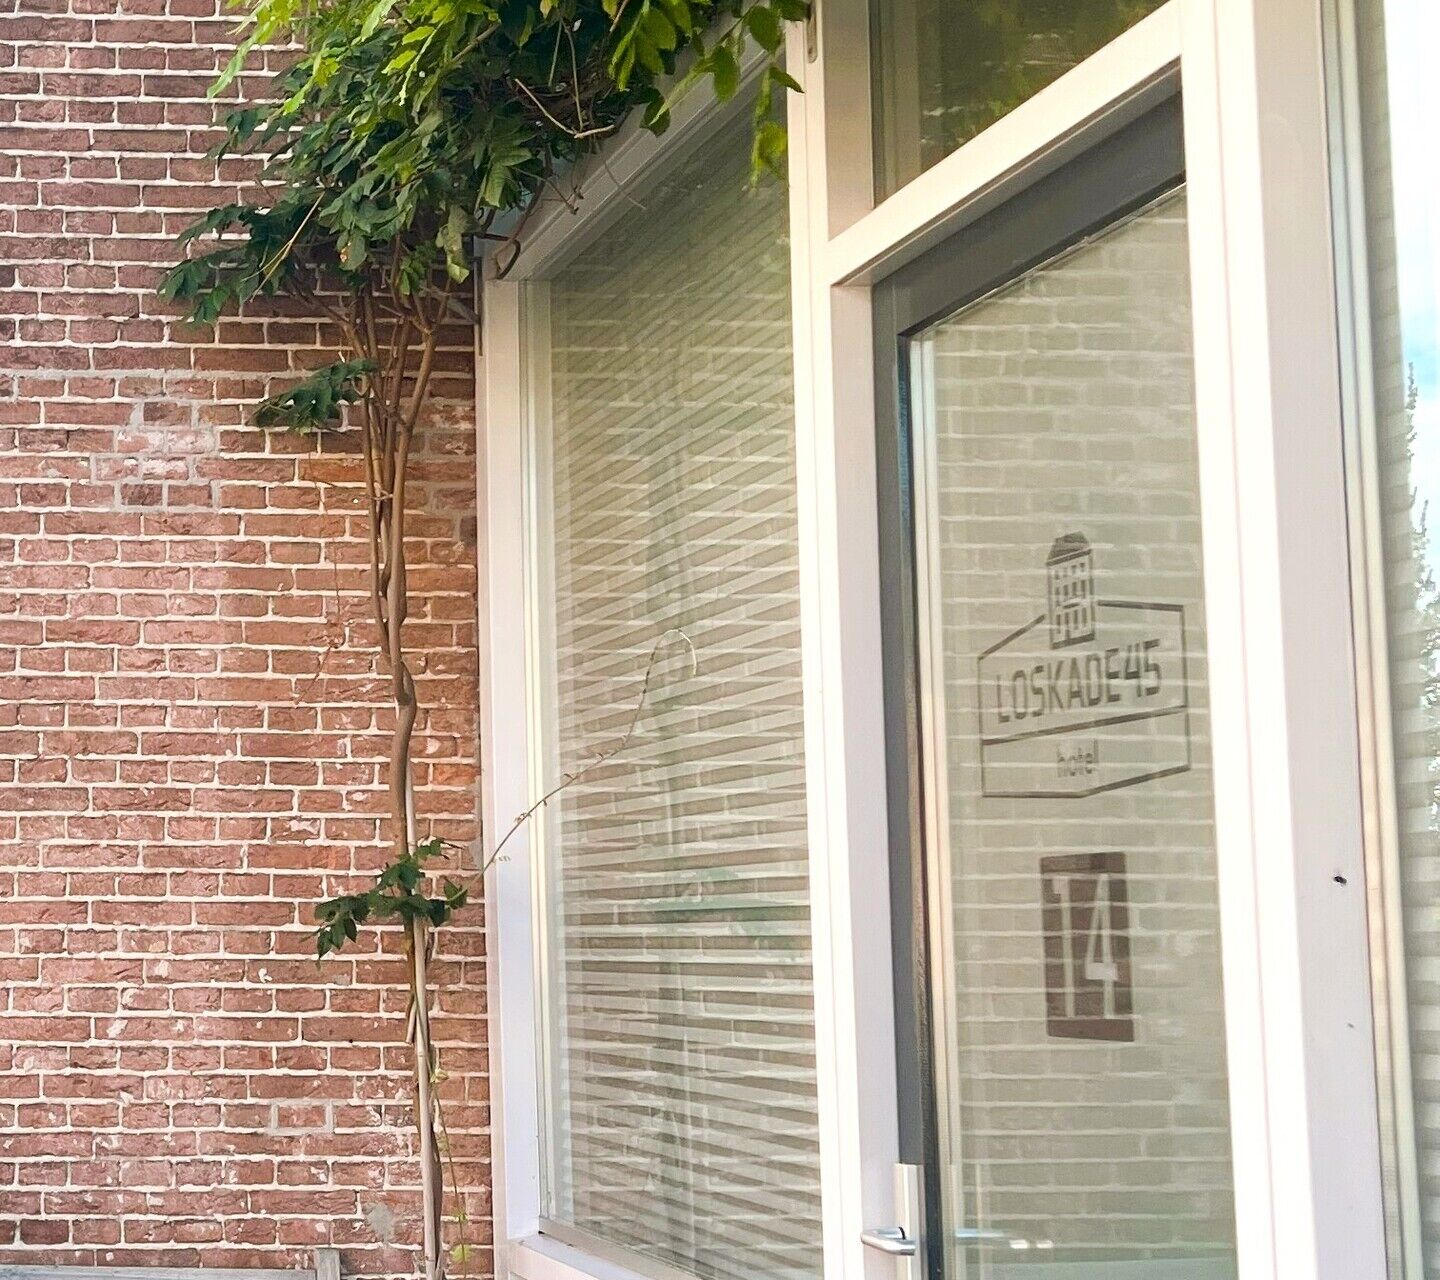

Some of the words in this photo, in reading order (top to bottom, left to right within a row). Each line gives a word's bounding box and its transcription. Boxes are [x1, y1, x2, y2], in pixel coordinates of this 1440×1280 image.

[996, 638, 1162, 724] LOSKADE45
[1057, 738, 1099, 778] hotel
[1052, 873, 1118, 1019] 14
